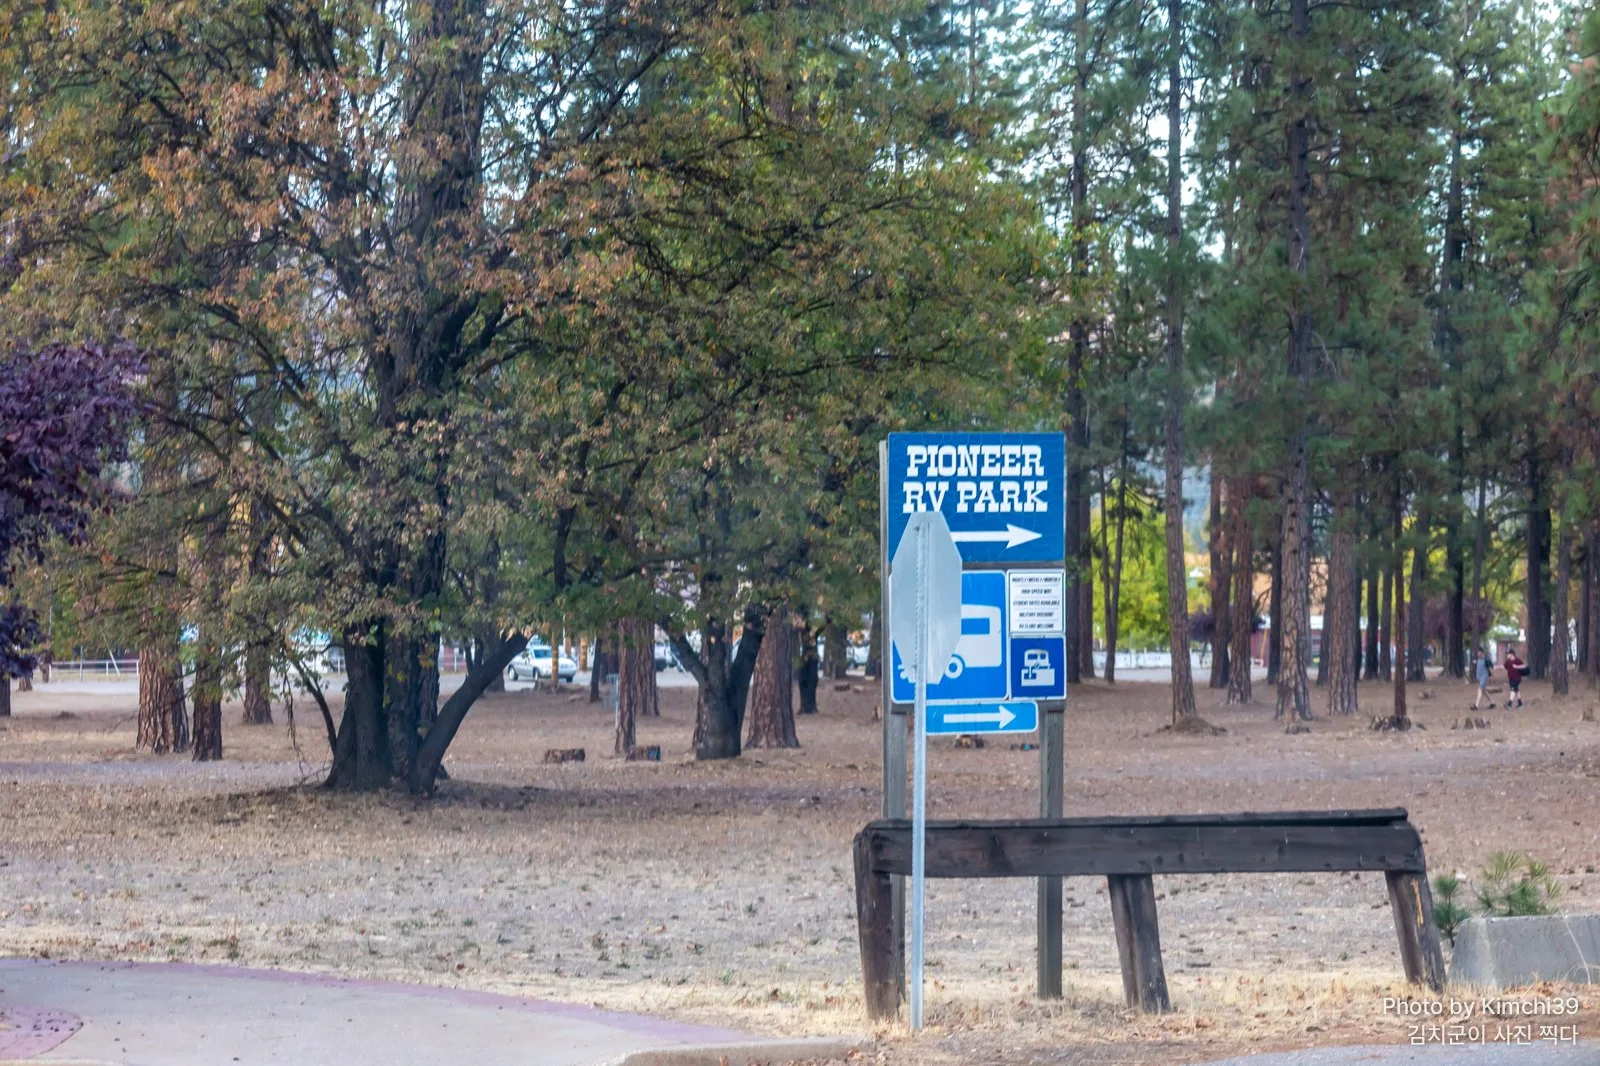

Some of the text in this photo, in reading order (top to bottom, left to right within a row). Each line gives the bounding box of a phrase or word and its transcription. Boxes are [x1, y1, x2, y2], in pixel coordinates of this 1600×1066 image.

[906, 444, 1045, 477] PIONEER
[902, 480, 1048, 513] RV PARK
